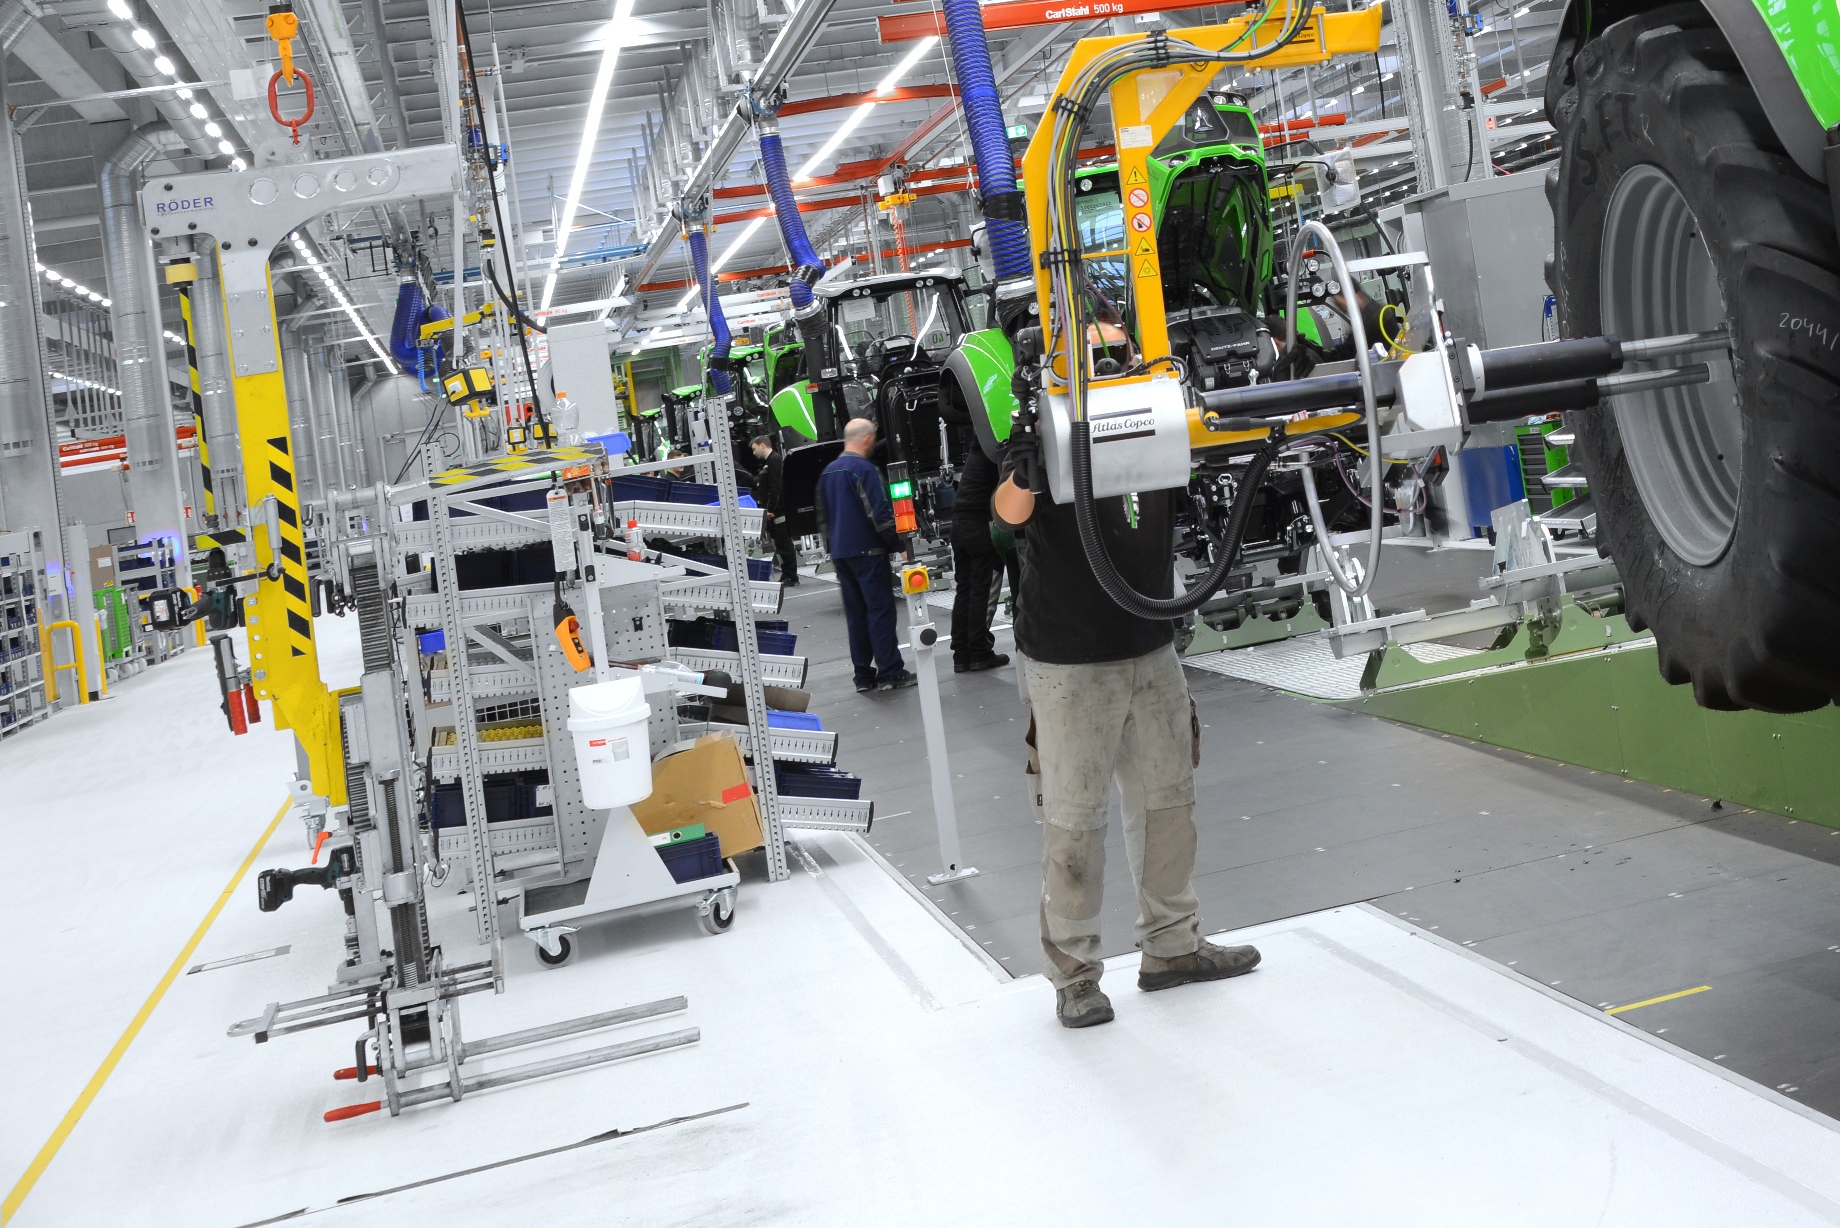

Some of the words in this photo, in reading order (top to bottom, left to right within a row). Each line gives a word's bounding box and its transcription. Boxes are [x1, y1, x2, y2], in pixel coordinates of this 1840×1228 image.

[1093, 2, 1110, 14] 500
[1112, 2, 1124, 14] kg
[156, 196, 215, 213] RÖDER
[1091, 421, 1123, 434] Atlas
[1124, 418, 1155, 429] Copco
